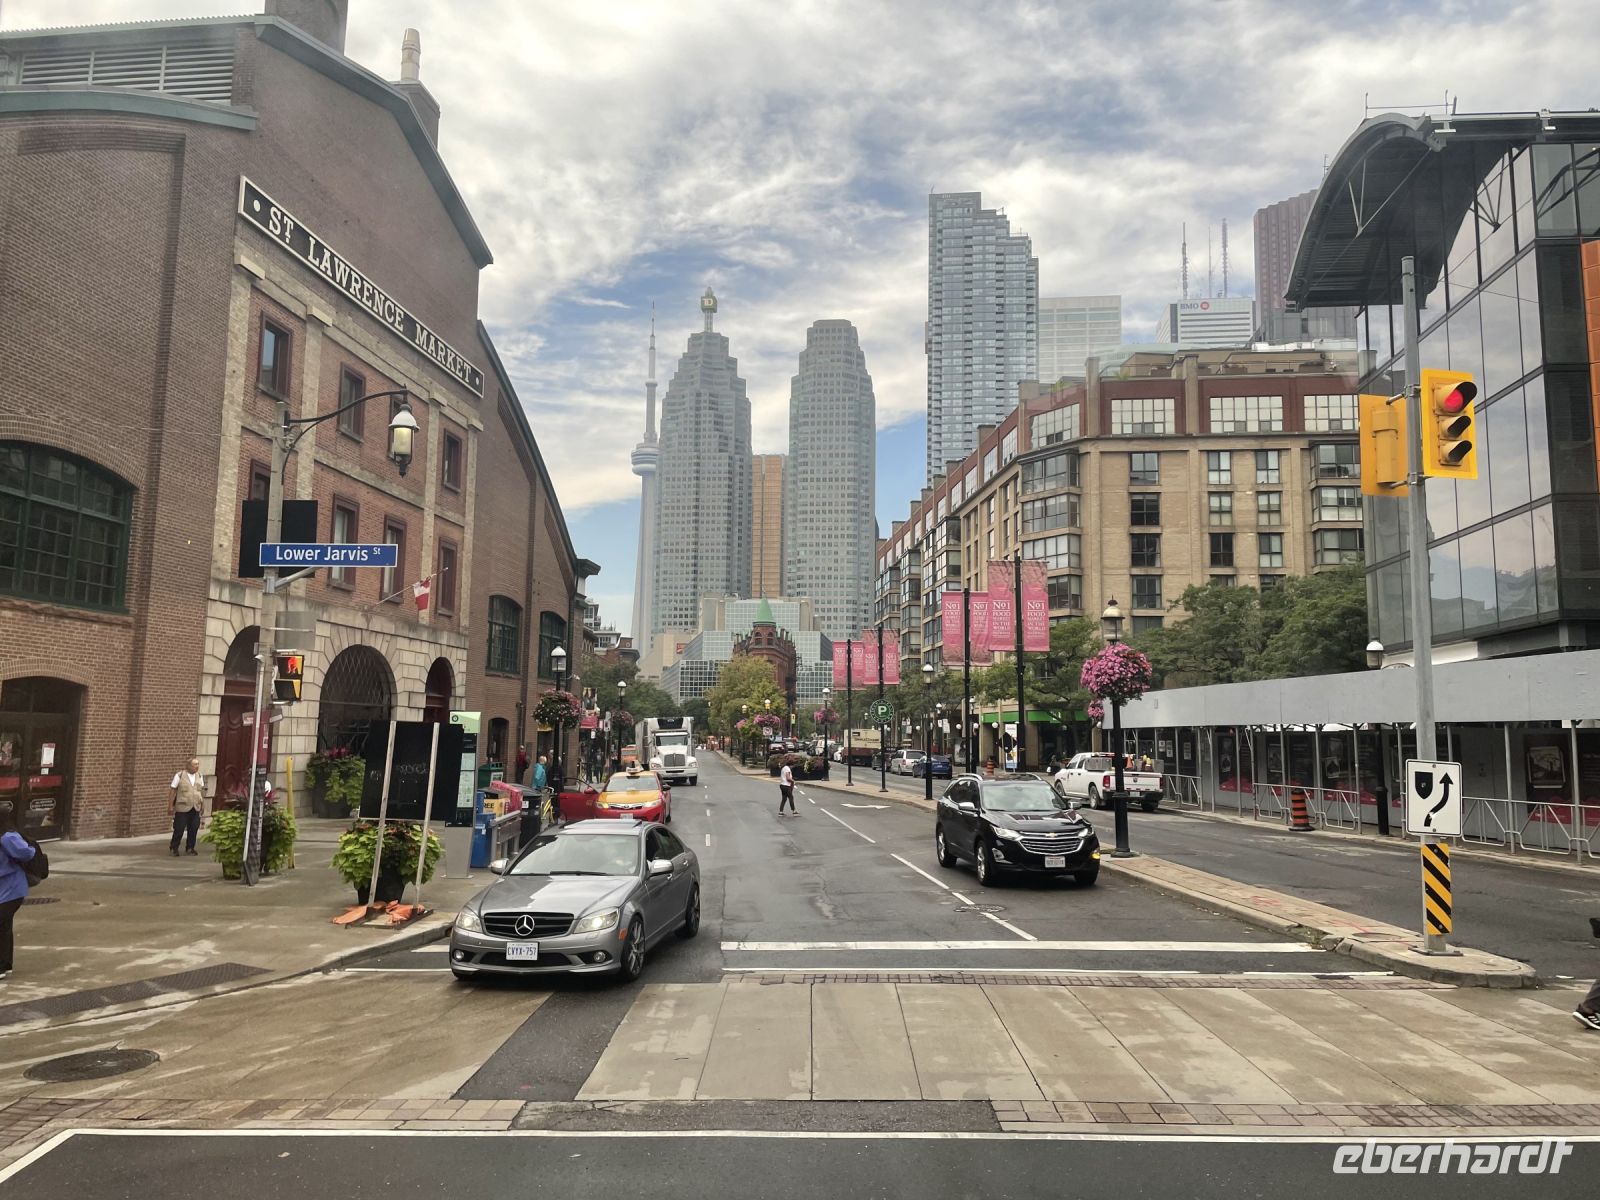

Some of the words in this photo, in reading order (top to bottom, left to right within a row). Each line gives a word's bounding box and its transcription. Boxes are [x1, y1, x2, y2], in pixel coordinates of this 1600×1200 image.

[308, 237, 404, 331] LAWRENCE
[415, 323, 471, 383] MARKET
[276, 546, 320, 560] Lower
[324, 546, 368, 561] Jarvis
[373, 547, 381, 555] St
[878, 705, 887, 715] P
